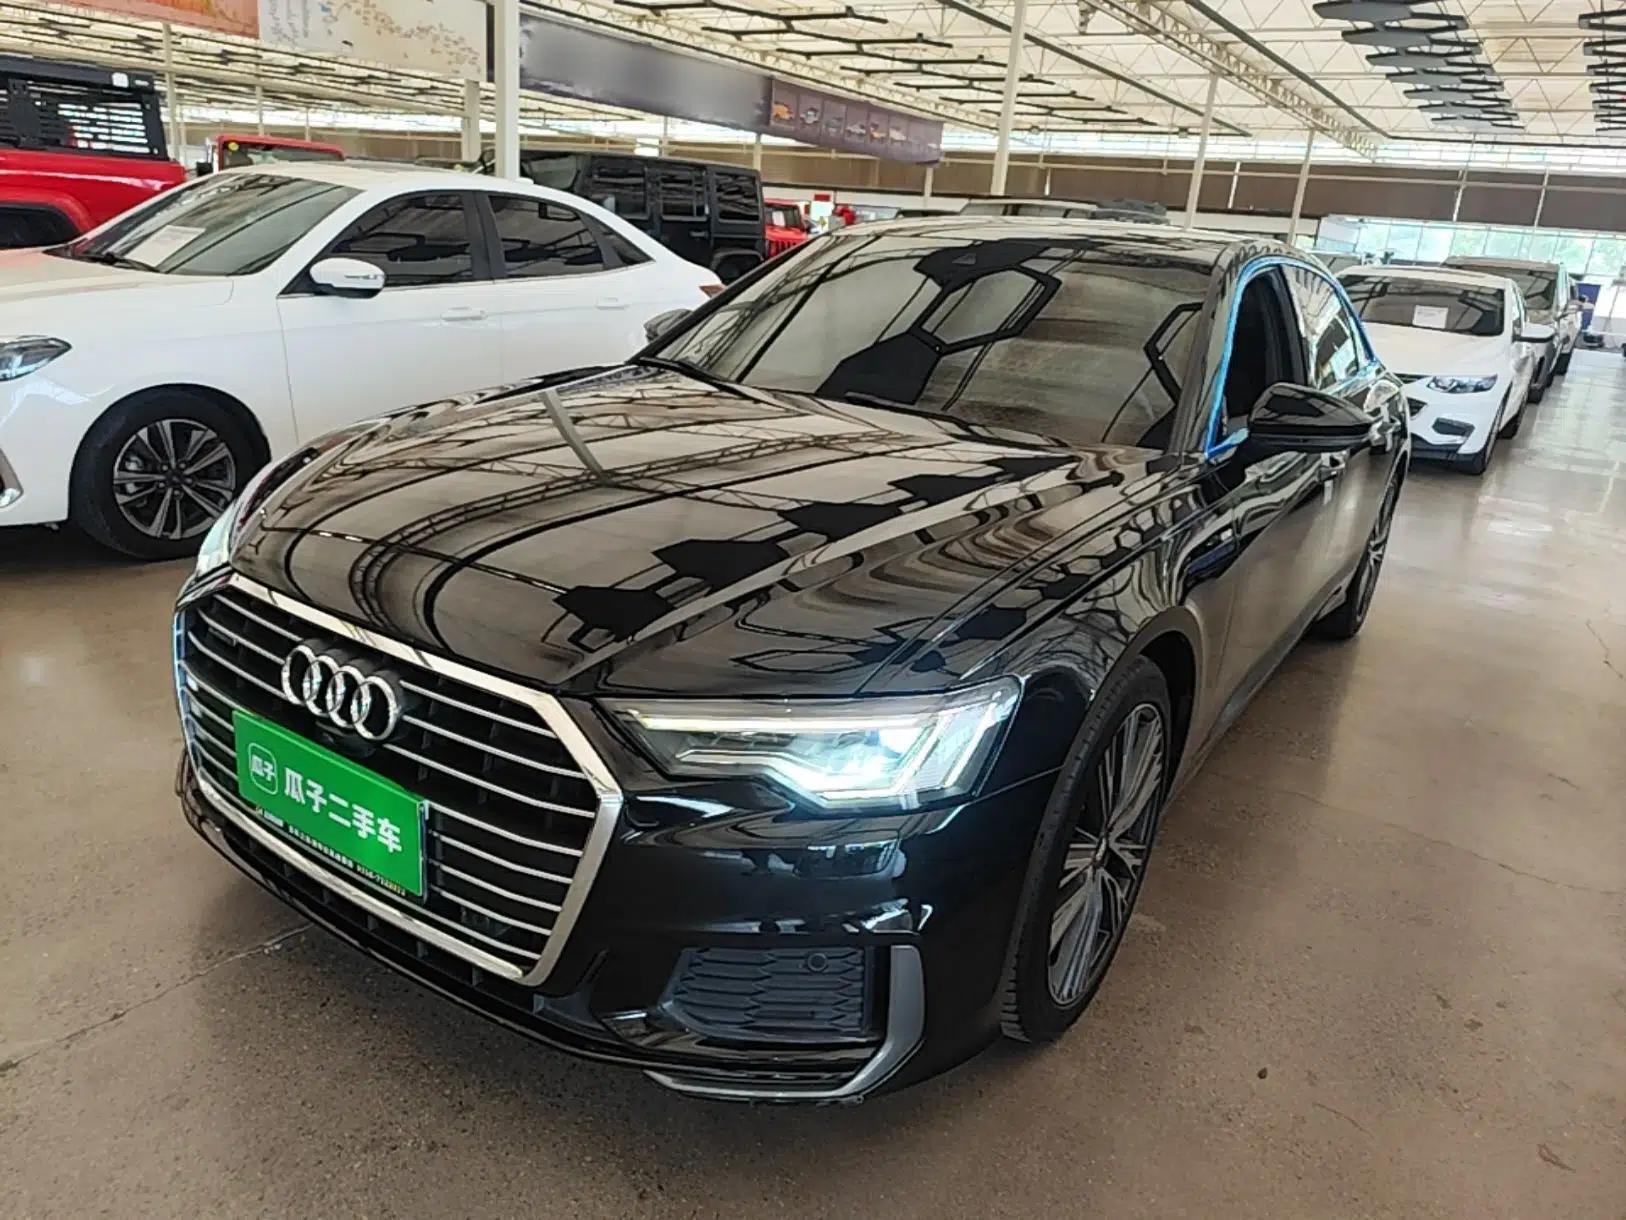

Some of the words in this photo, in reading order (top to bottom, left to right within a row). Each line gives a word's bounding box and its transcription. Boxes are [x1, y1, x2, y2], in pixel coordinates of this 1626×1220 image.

[251, 754, 275, 781] 瓜子
[284, 767, 402, 853] 瓜子二手车
